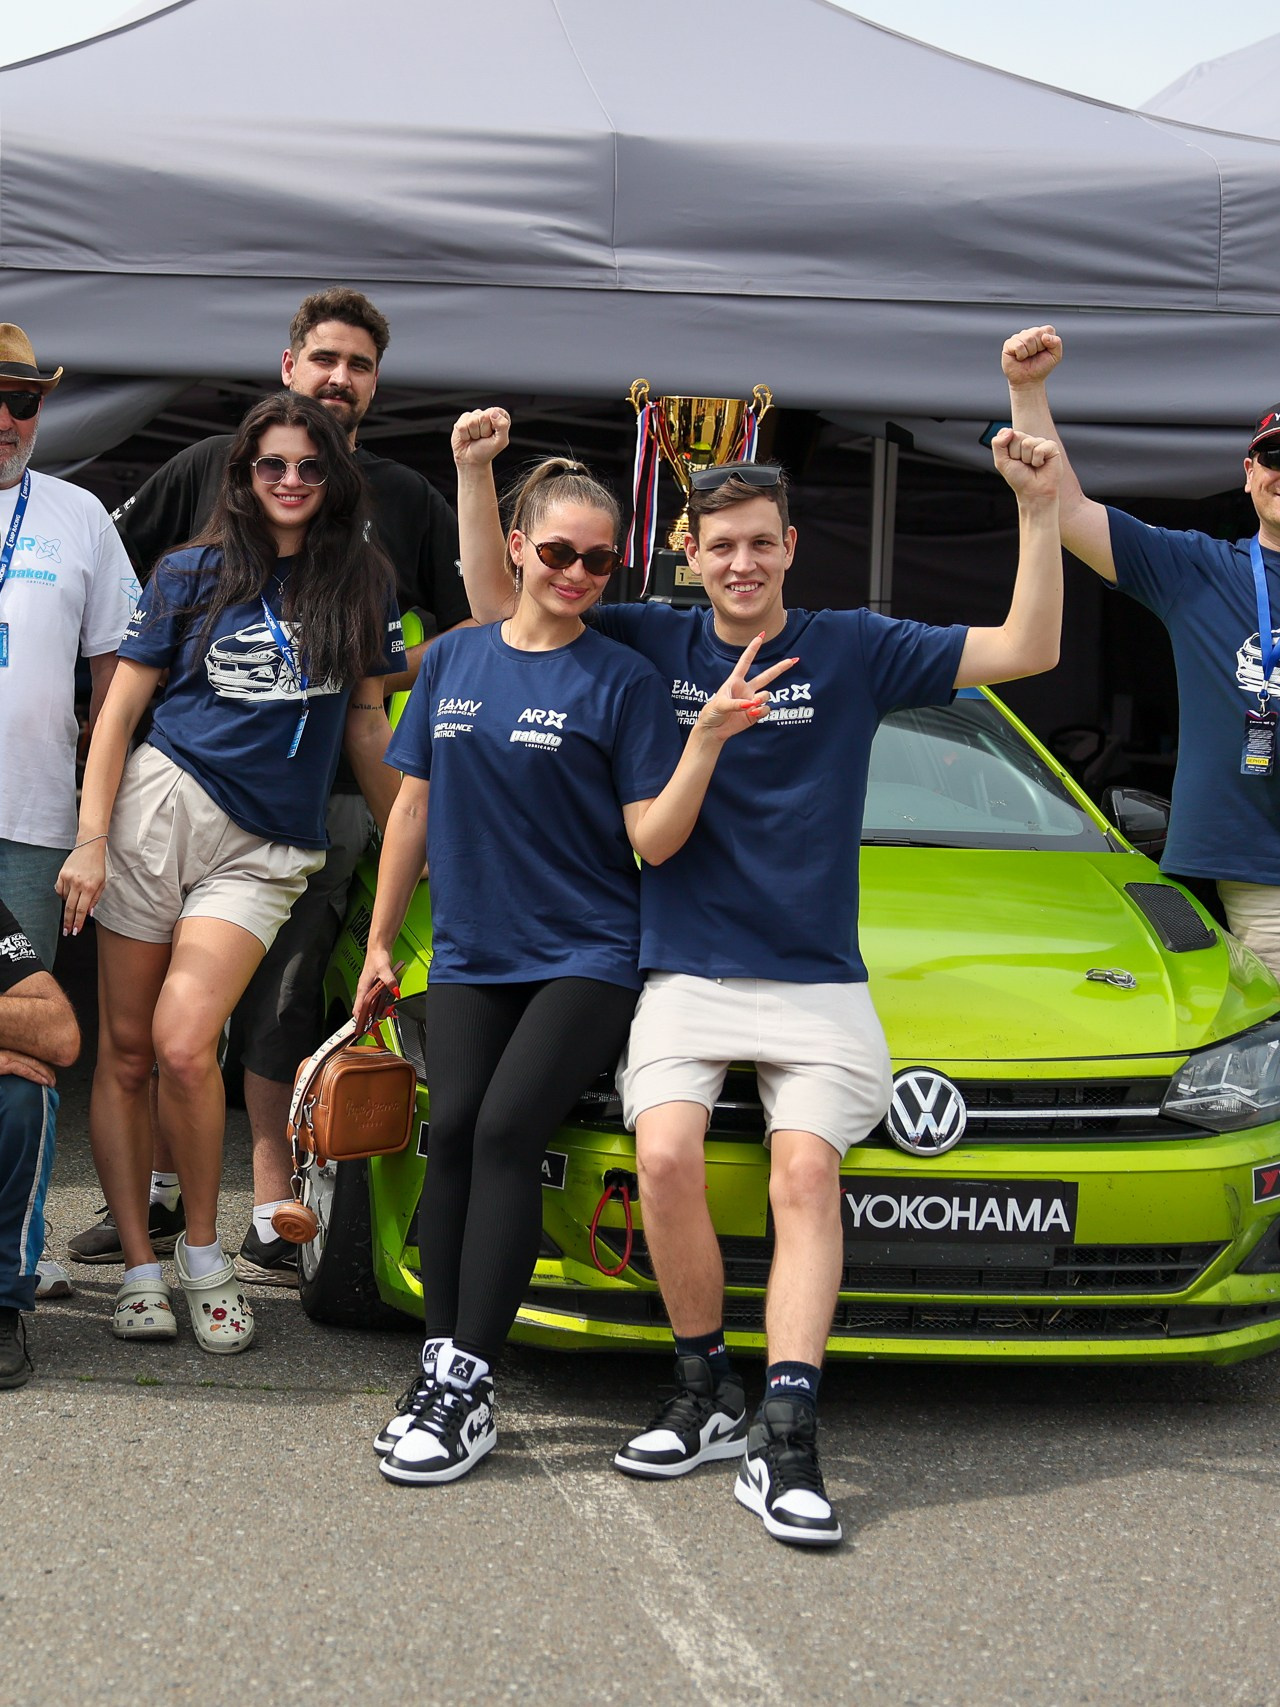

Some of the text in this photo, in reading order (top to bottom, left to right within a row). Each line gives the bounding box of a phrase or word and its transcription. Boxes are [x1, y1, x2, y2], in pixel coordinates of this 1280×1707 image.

[509, 730, 563, 747] pakelo
[846, 1193, 1071, 1233] YOKOHAMA
[771, 1375, 810, 1389] FILA
